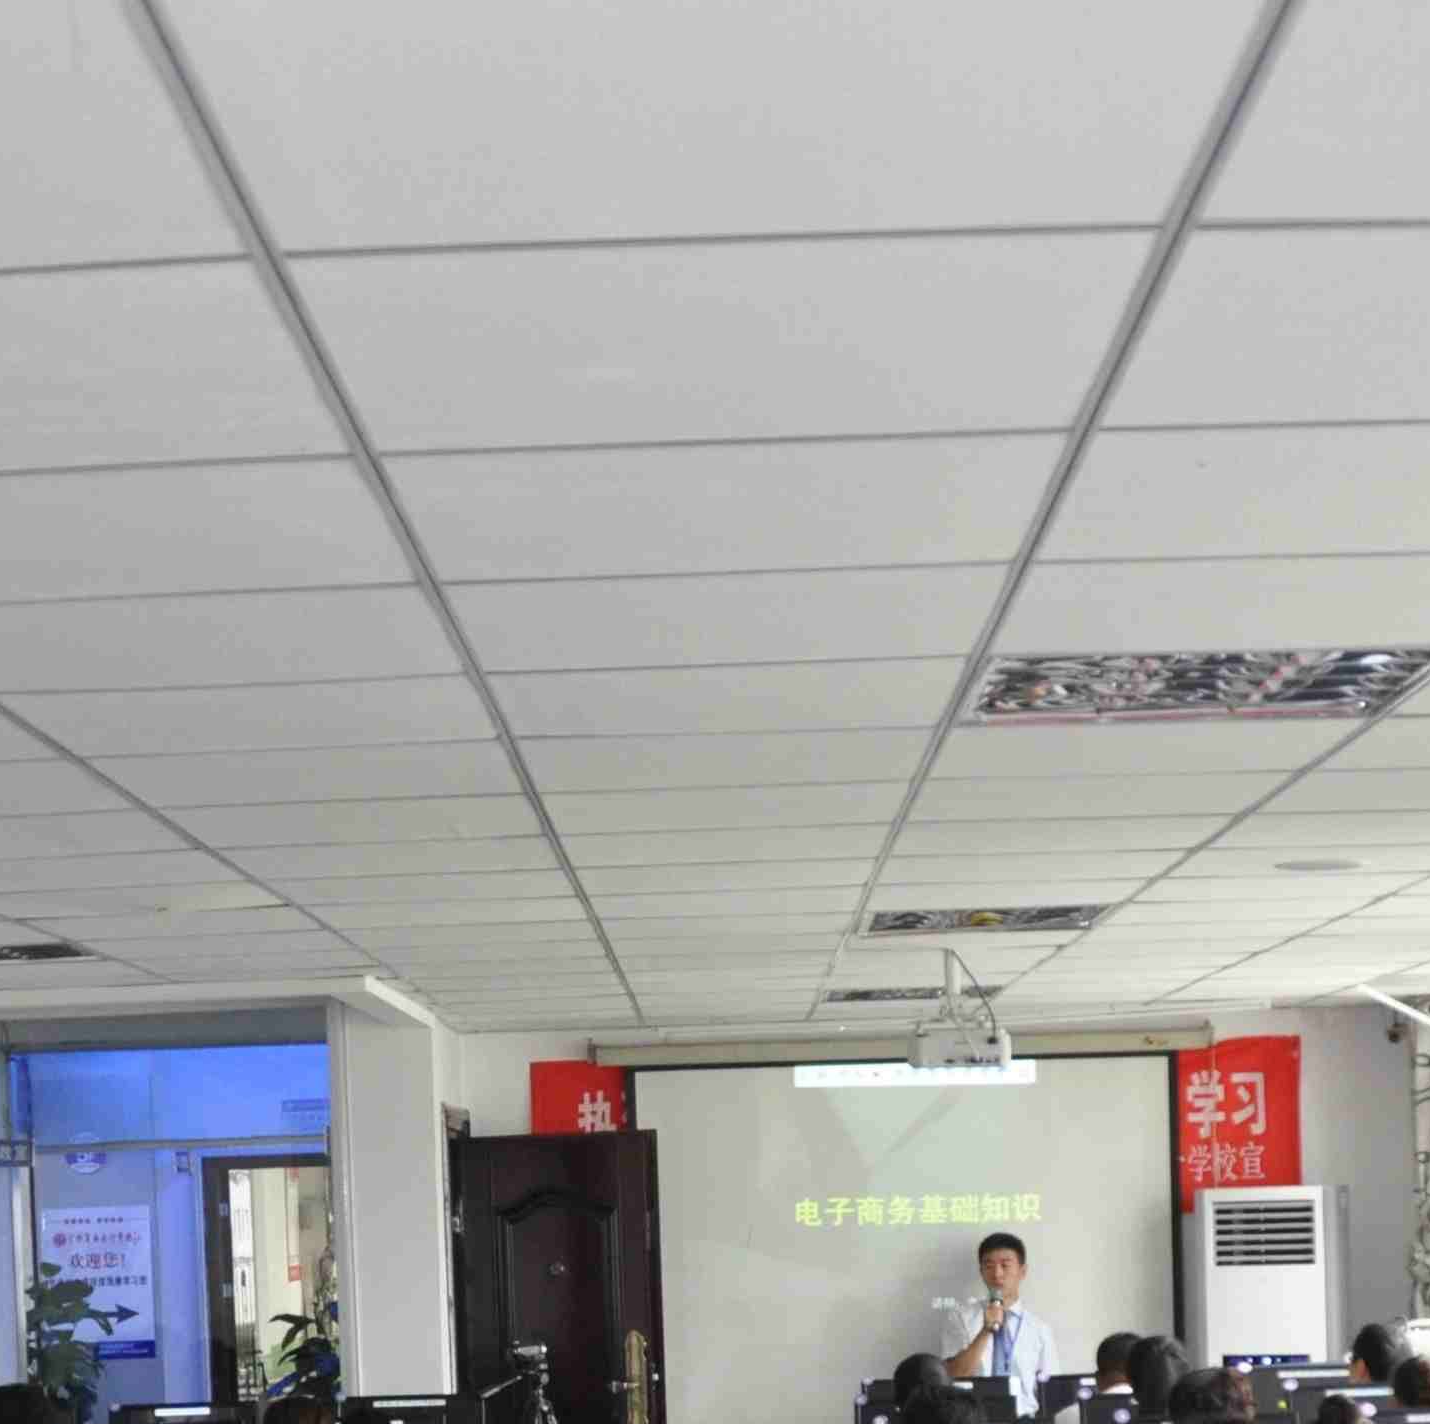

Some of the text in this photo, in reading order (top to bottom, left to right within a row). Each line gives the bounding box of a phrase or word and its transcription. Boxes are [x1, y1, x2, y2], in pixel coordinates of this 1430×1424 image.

[577, 1089, 628, 1134] 执
[1187, 1070, 1267, 1138] 学习
[1179, 1143, 1266, 1182] 学校宣
[794, 1193, 1042, 1228] 电子商务基础知识
